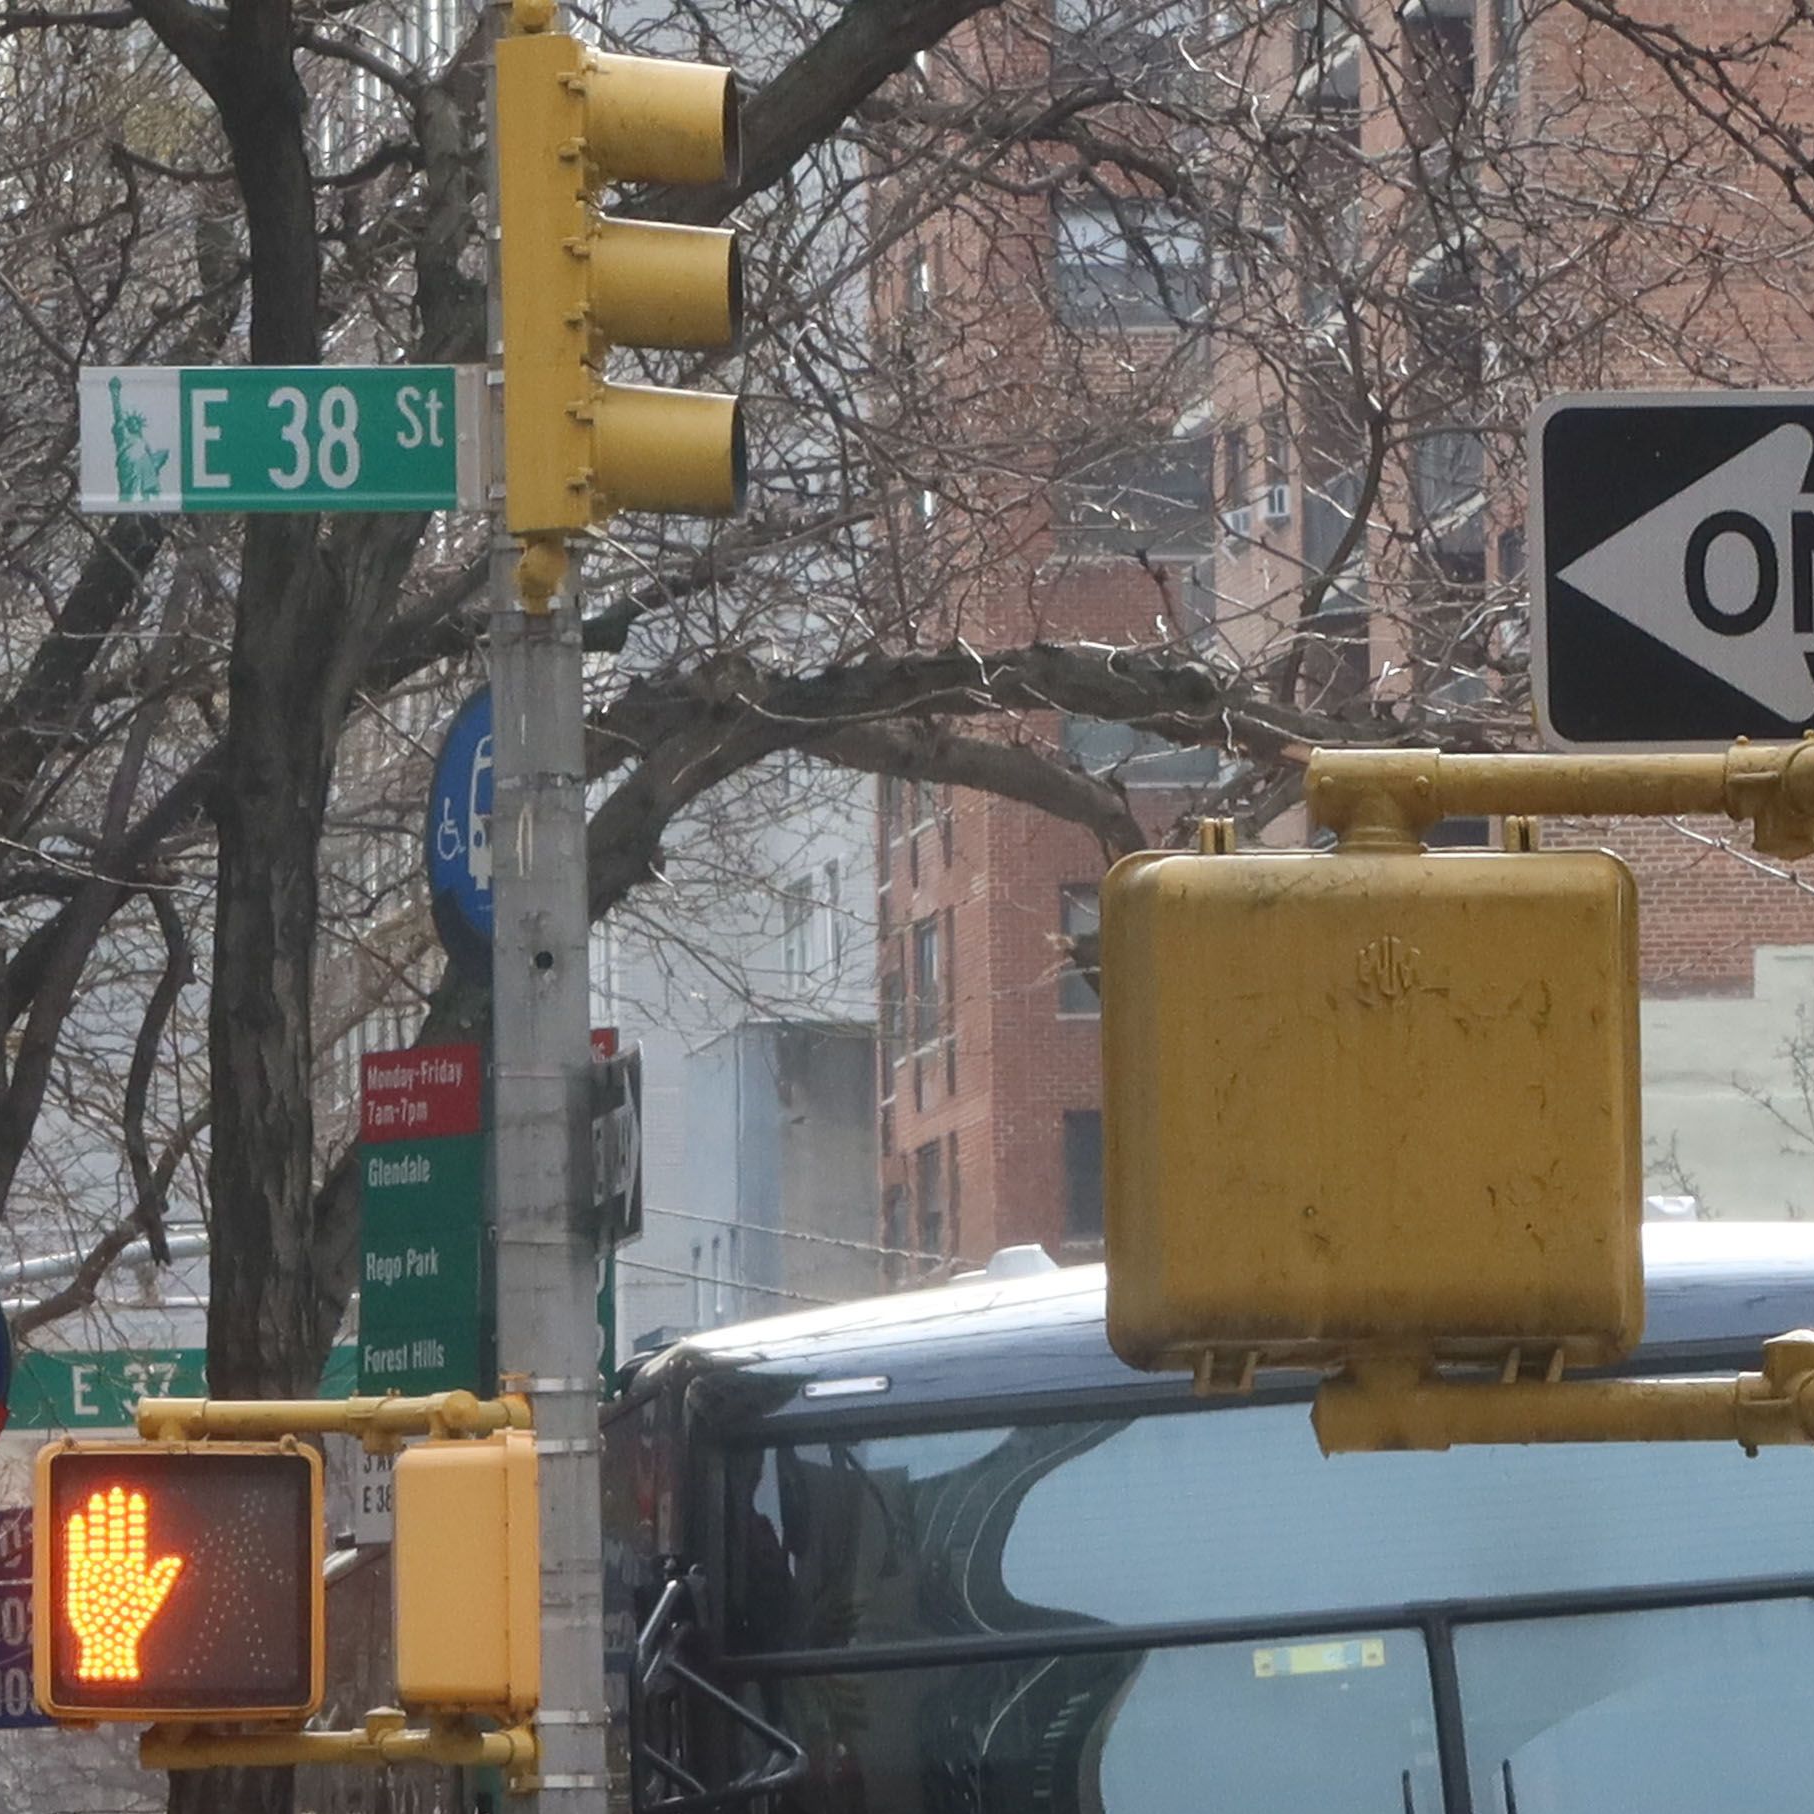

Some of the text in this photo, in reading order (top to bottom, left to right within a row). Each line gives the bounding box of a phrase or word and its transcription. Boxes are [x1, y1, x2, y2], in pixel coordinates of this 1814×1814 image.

[191, 386, 446, 490] E 38 St
[366, 1056, 464, 1091] Monday-Friday
[366, 1098, 428, 1129] 7am-7pm
[367, 1153, 431, 1188] Glendale
[366, 1247, 440, 1287] Rego Park
[364, 1339, 445, 1374] Forest Hills
[71, 1365, 99, 1416] E
